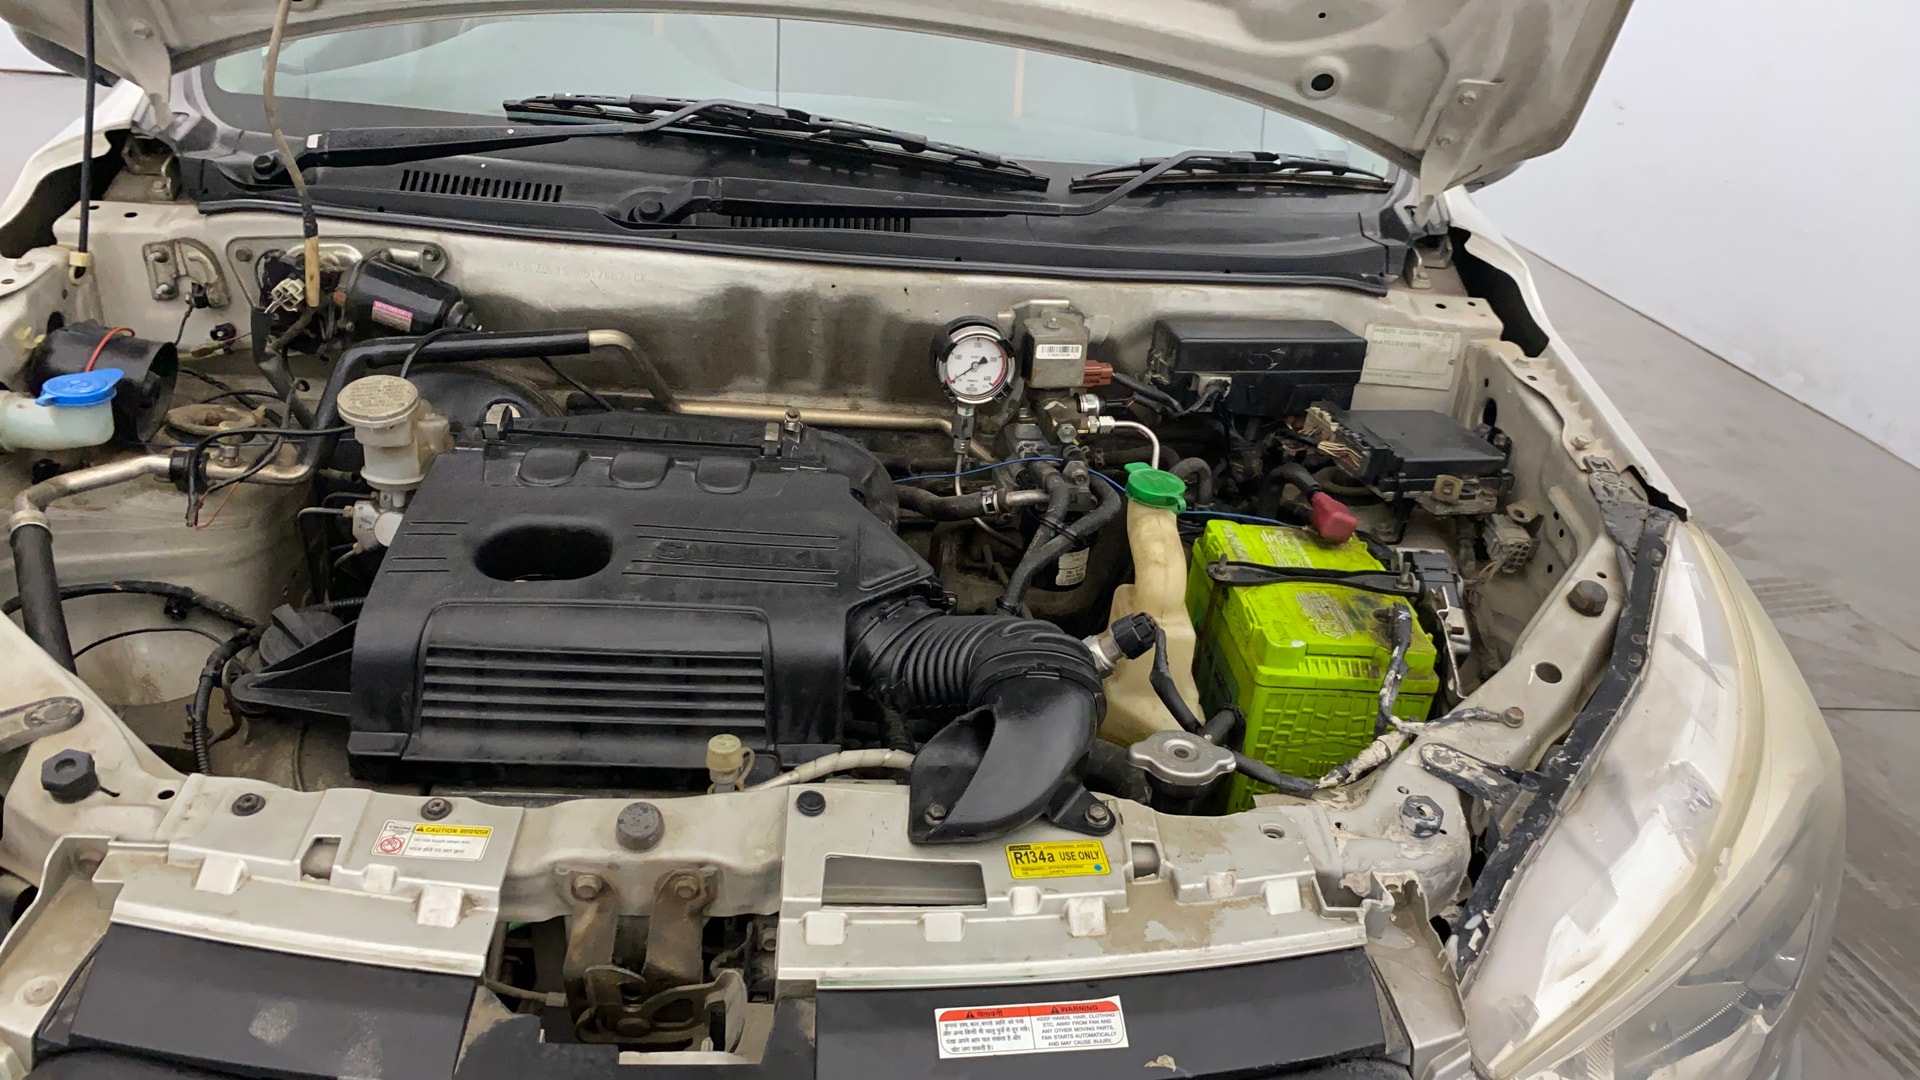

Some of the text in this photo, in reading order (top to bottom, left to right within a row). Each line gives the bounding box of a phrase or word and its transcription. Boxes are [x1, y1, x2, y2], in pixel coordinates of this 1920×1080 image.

[1014, 850, 1099, 864] R134a USE ONLY
